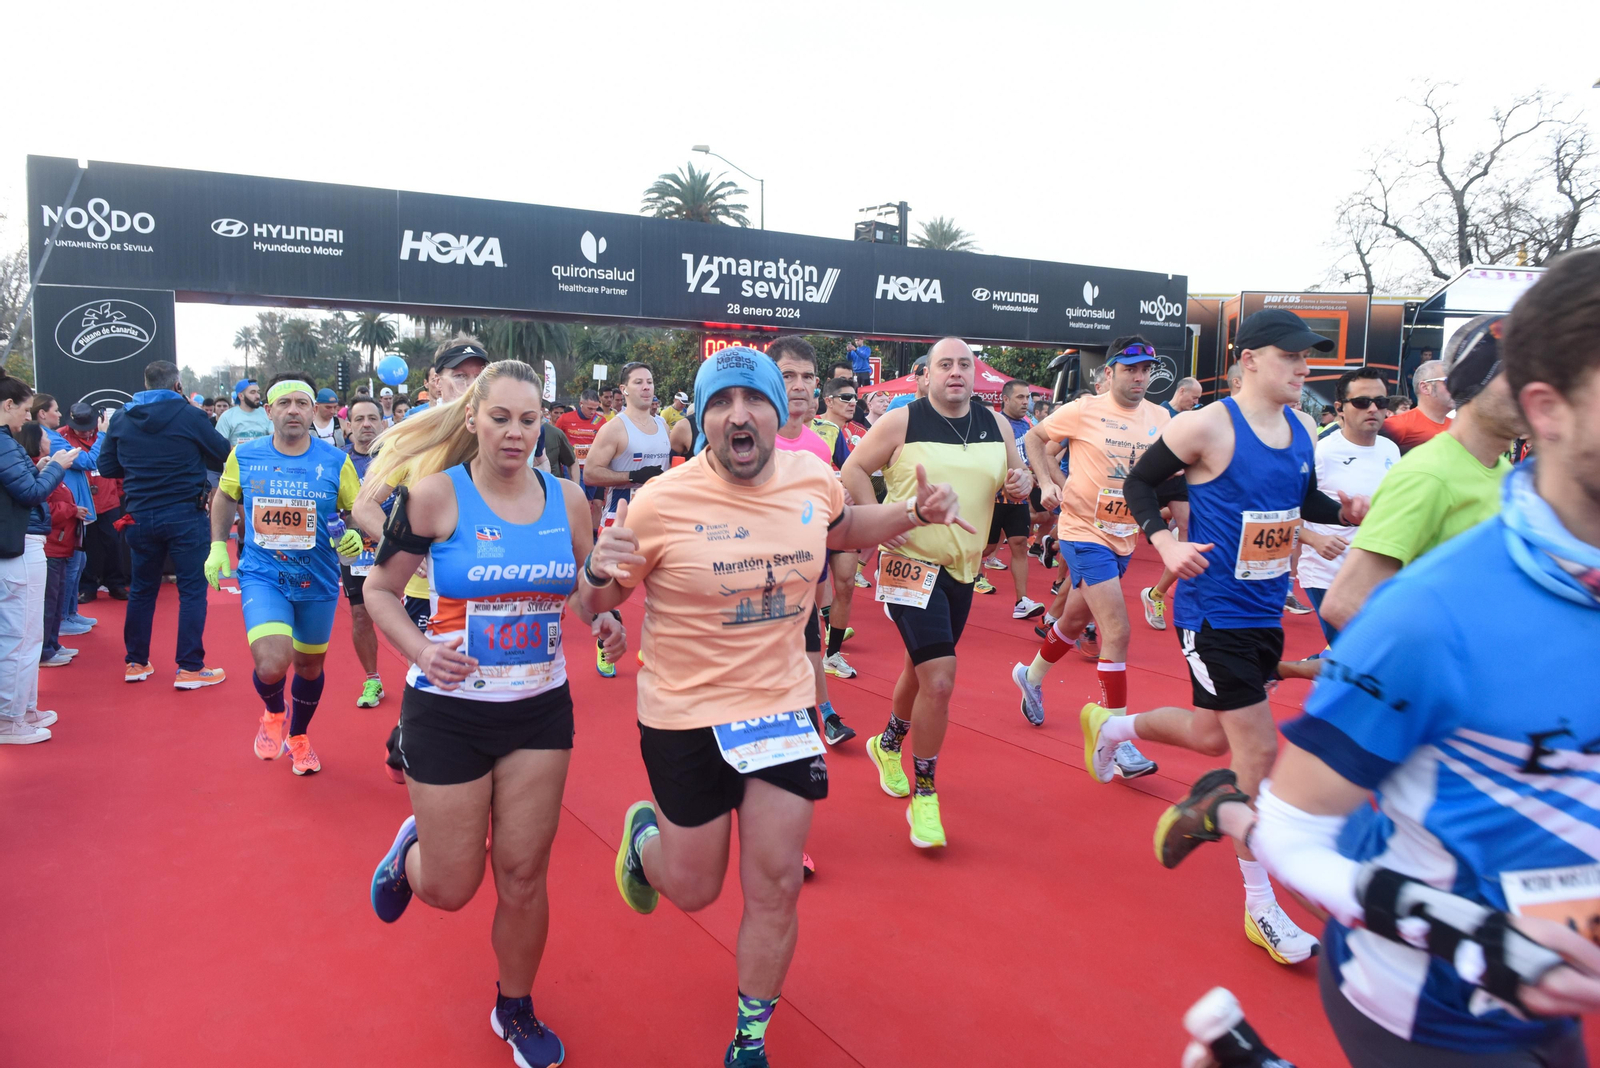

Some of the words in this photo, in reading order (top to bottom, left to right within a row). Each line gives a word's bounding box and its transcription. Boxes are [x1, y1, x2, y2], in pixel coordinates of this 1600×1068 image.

[253, 223, 344, 243] HYUNDAI
[44, 237, 109, 250] AUNTAMIENTO
[253, 241, 312, 254] Hyundauto
[313, 246, 344, 256] Motor
[400, 229, 504, 268] HOKA
[713, 256, 818, 283] maratón
[558, 282, 600, 294] Healthcare
[600, 285, 628, 296] Partner
[741, 279, 820, 303] sevilla
[875, 274, 943, 304] HOKA
[993, 290, 1039, 304] HYUNDAI
[727, 303, 741, 315] 28
[742, 306, 773, 317] enero
[775, 307, 800, 318] 2024
[101, 327, 110, 335] de
[111, 325, 139, 337] Canarias
[1069, 321, 1094, 330] Healthcare
[1094, 322, 1111, 330] Partner
[270, 480, 309, 490] ESTATE
[270, 488, 327, 499] BARCELONA
[1104, 500, 1133, 517] 471
[261, 510, 302, 527] 4469
[1252, 526, 1292, 549] 4634
[713, 556, 764, 573] Maratón
[773, 549, 812, 564] Sevilla
[467, 560, 575, 583] enerplus
[885, 559, 922, 581] 4803
[527, 601, 553, 613] SEVILLA
[483, 621, 543, 650] 1883
[1257, 916, 1282, 949] HOKA
